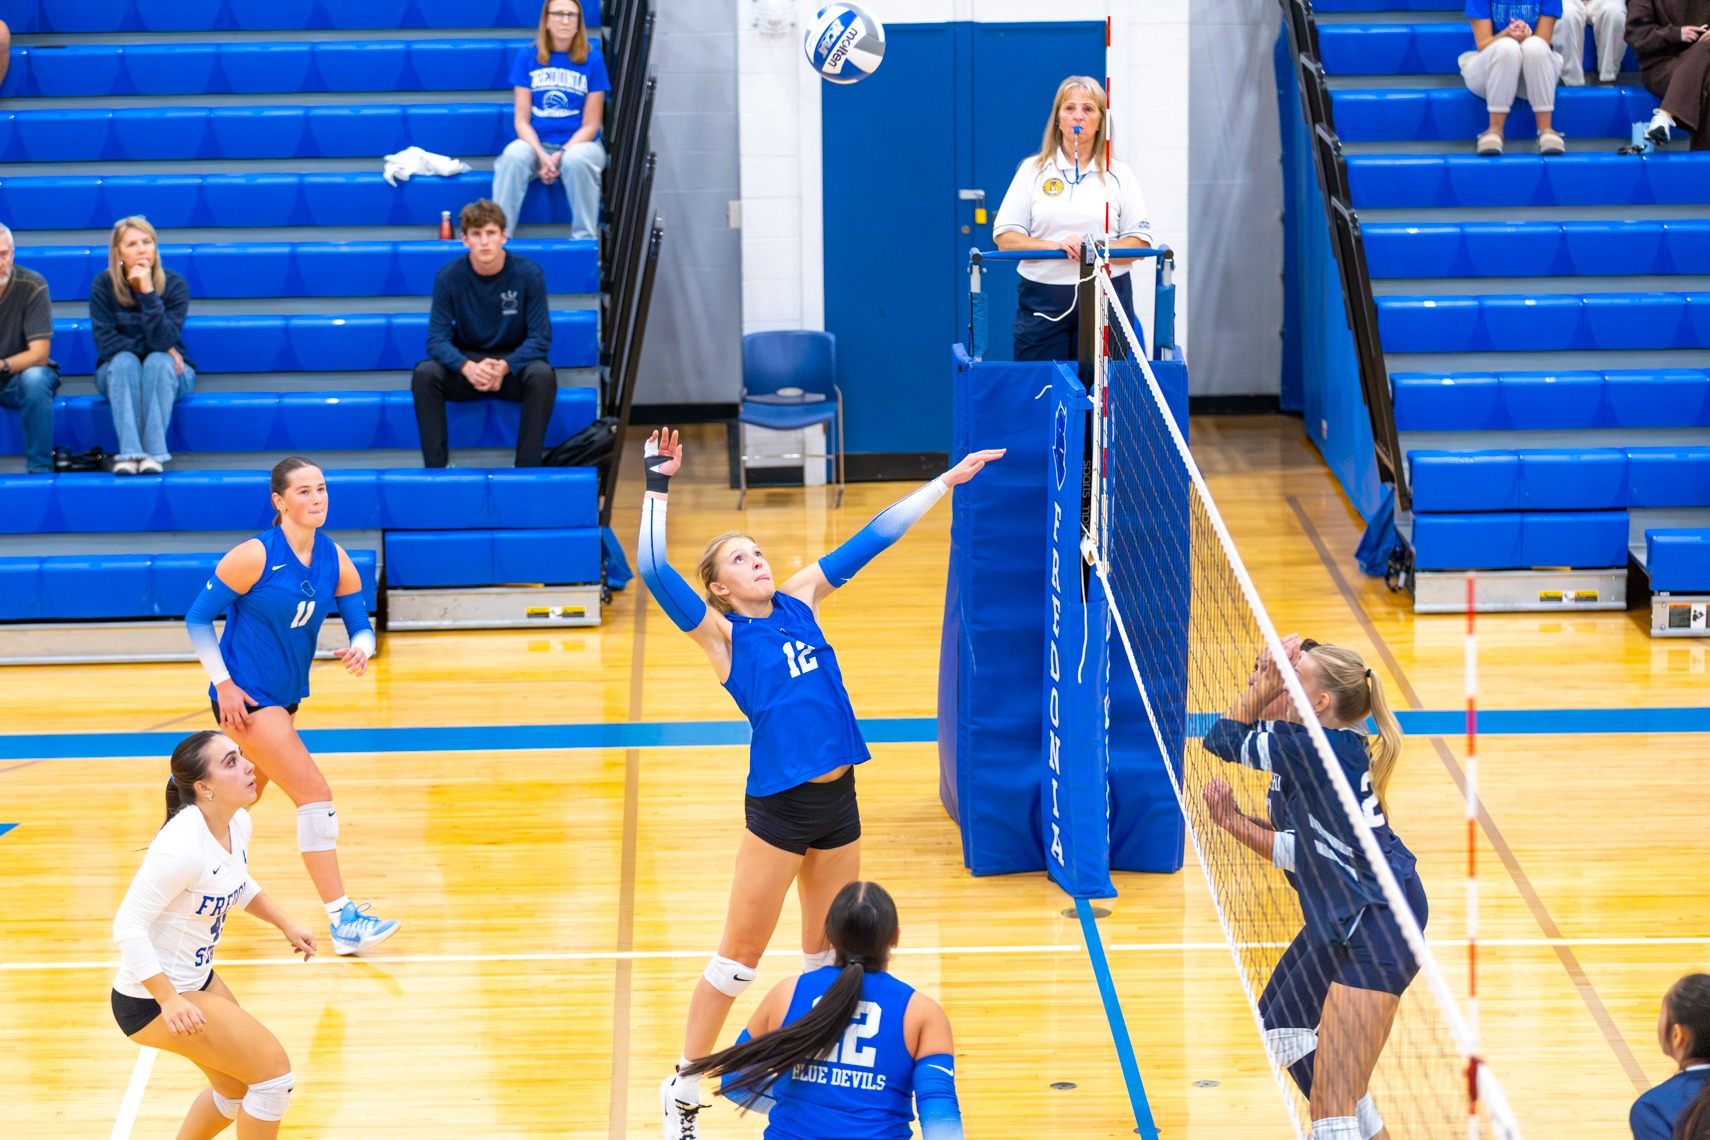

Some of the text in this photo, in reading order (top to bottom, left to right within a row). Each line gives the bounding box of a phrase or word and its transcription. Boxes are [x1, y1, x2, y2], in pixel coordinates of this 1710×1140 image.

[827, 27, 859, 69] molten
[290, 600, 316, 629] 11
[782, 639, 819, 679] 12
[1048, 500, 1066, 868] FREDONIA
[830, 1067, 887, 1091] DEVILS
